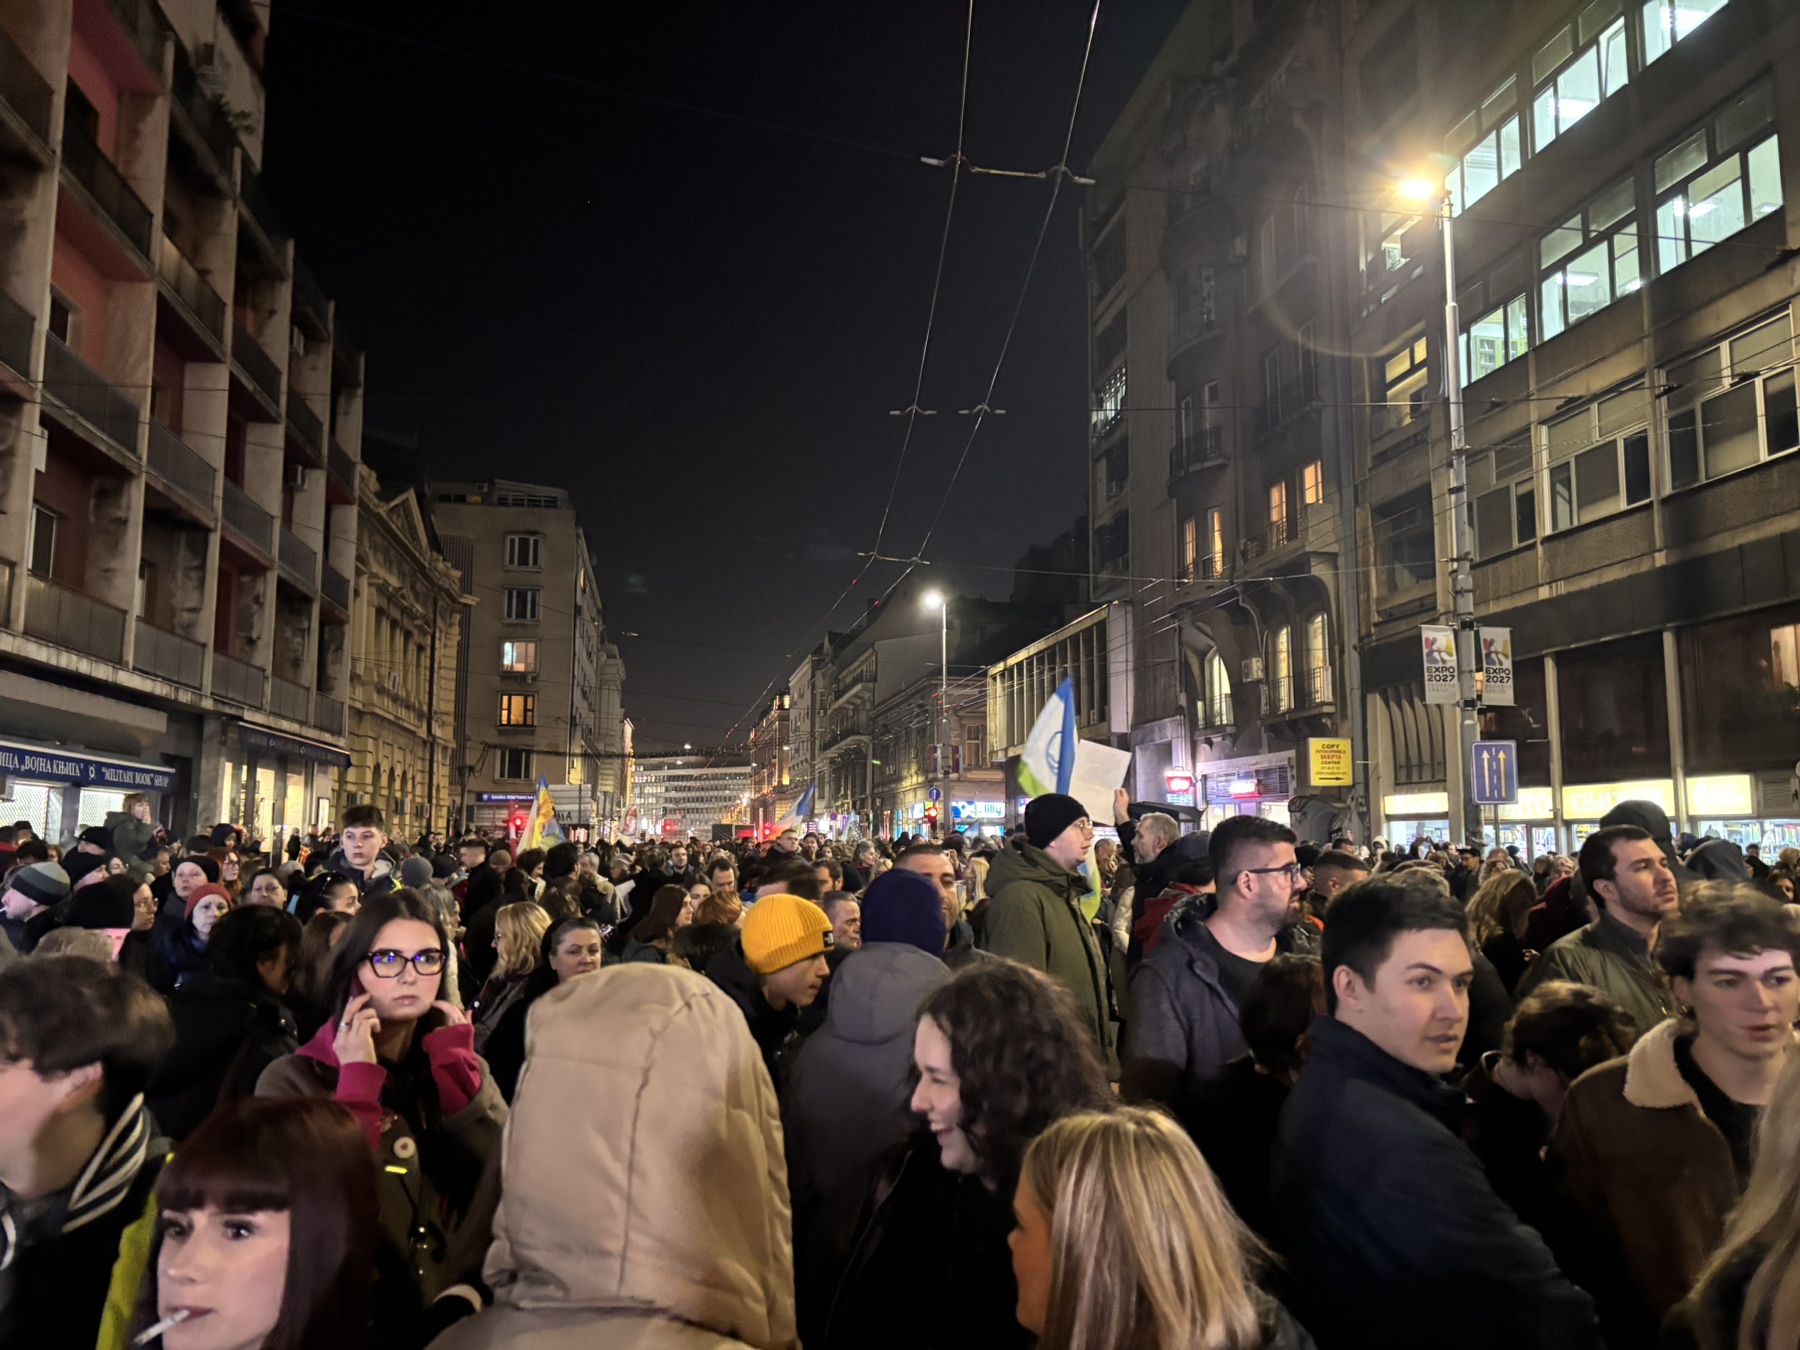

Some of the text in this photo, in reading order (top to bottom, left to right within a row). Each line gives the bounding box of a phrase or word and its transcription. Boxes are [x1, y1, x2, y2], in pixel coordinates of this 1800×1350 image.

[1426, 666, 1456, 674] EXPO
[1485, 667, 1511, 676] EXPO
[1426, 674, 1456, 682] 2027
[1485, 675, 1511, 684] 2027
[154, 774, 169, 788] SHOP
[984, 804, 1002, 816] lilly
